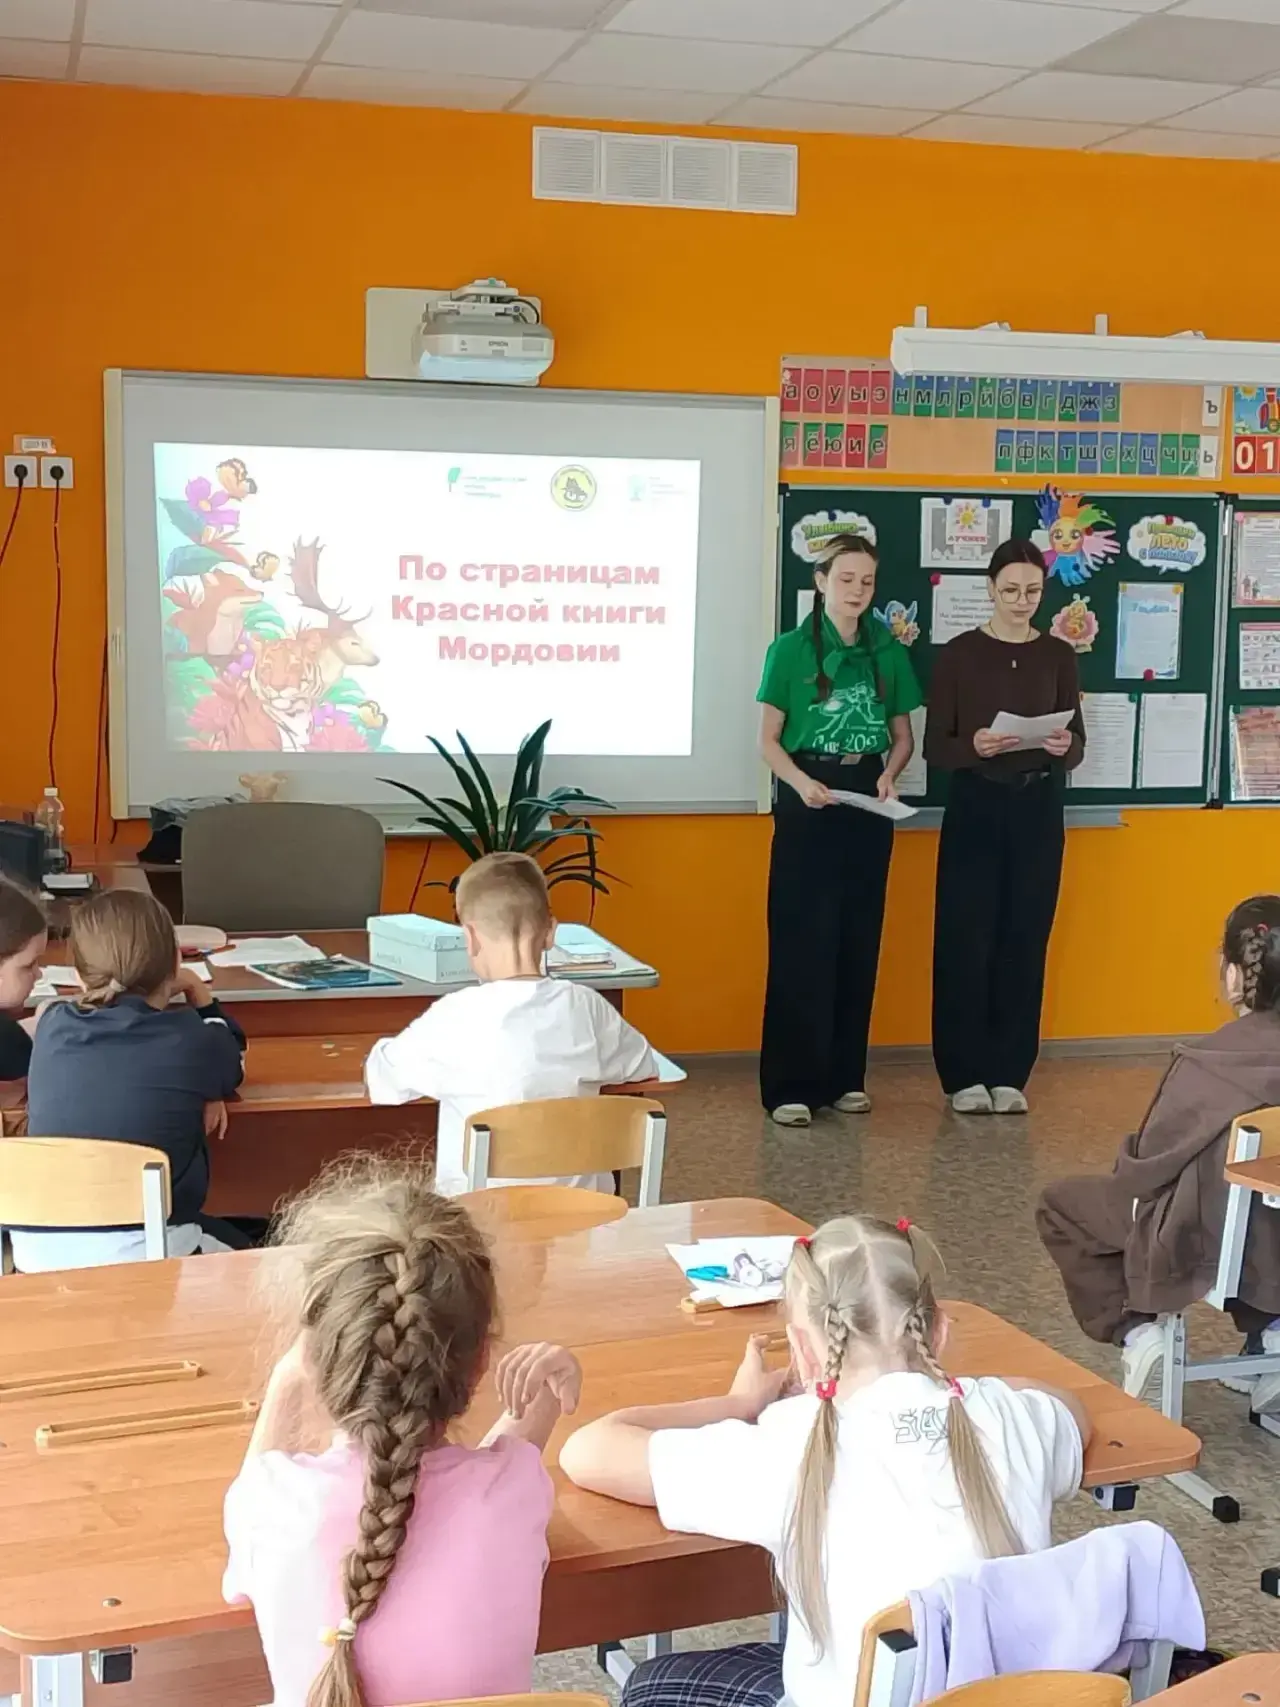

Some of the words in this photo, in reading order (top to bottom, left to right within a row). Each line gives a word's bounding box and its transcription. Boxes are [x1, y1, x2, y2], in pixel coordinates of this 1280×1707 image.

[398, 555, 447, 581] По
[459, 562, 660, 588] страницам
[391, 595, 549, 627] Красной
[562, 604, 667, 624] книги
[438, 636, 621, 667] Мордовии
